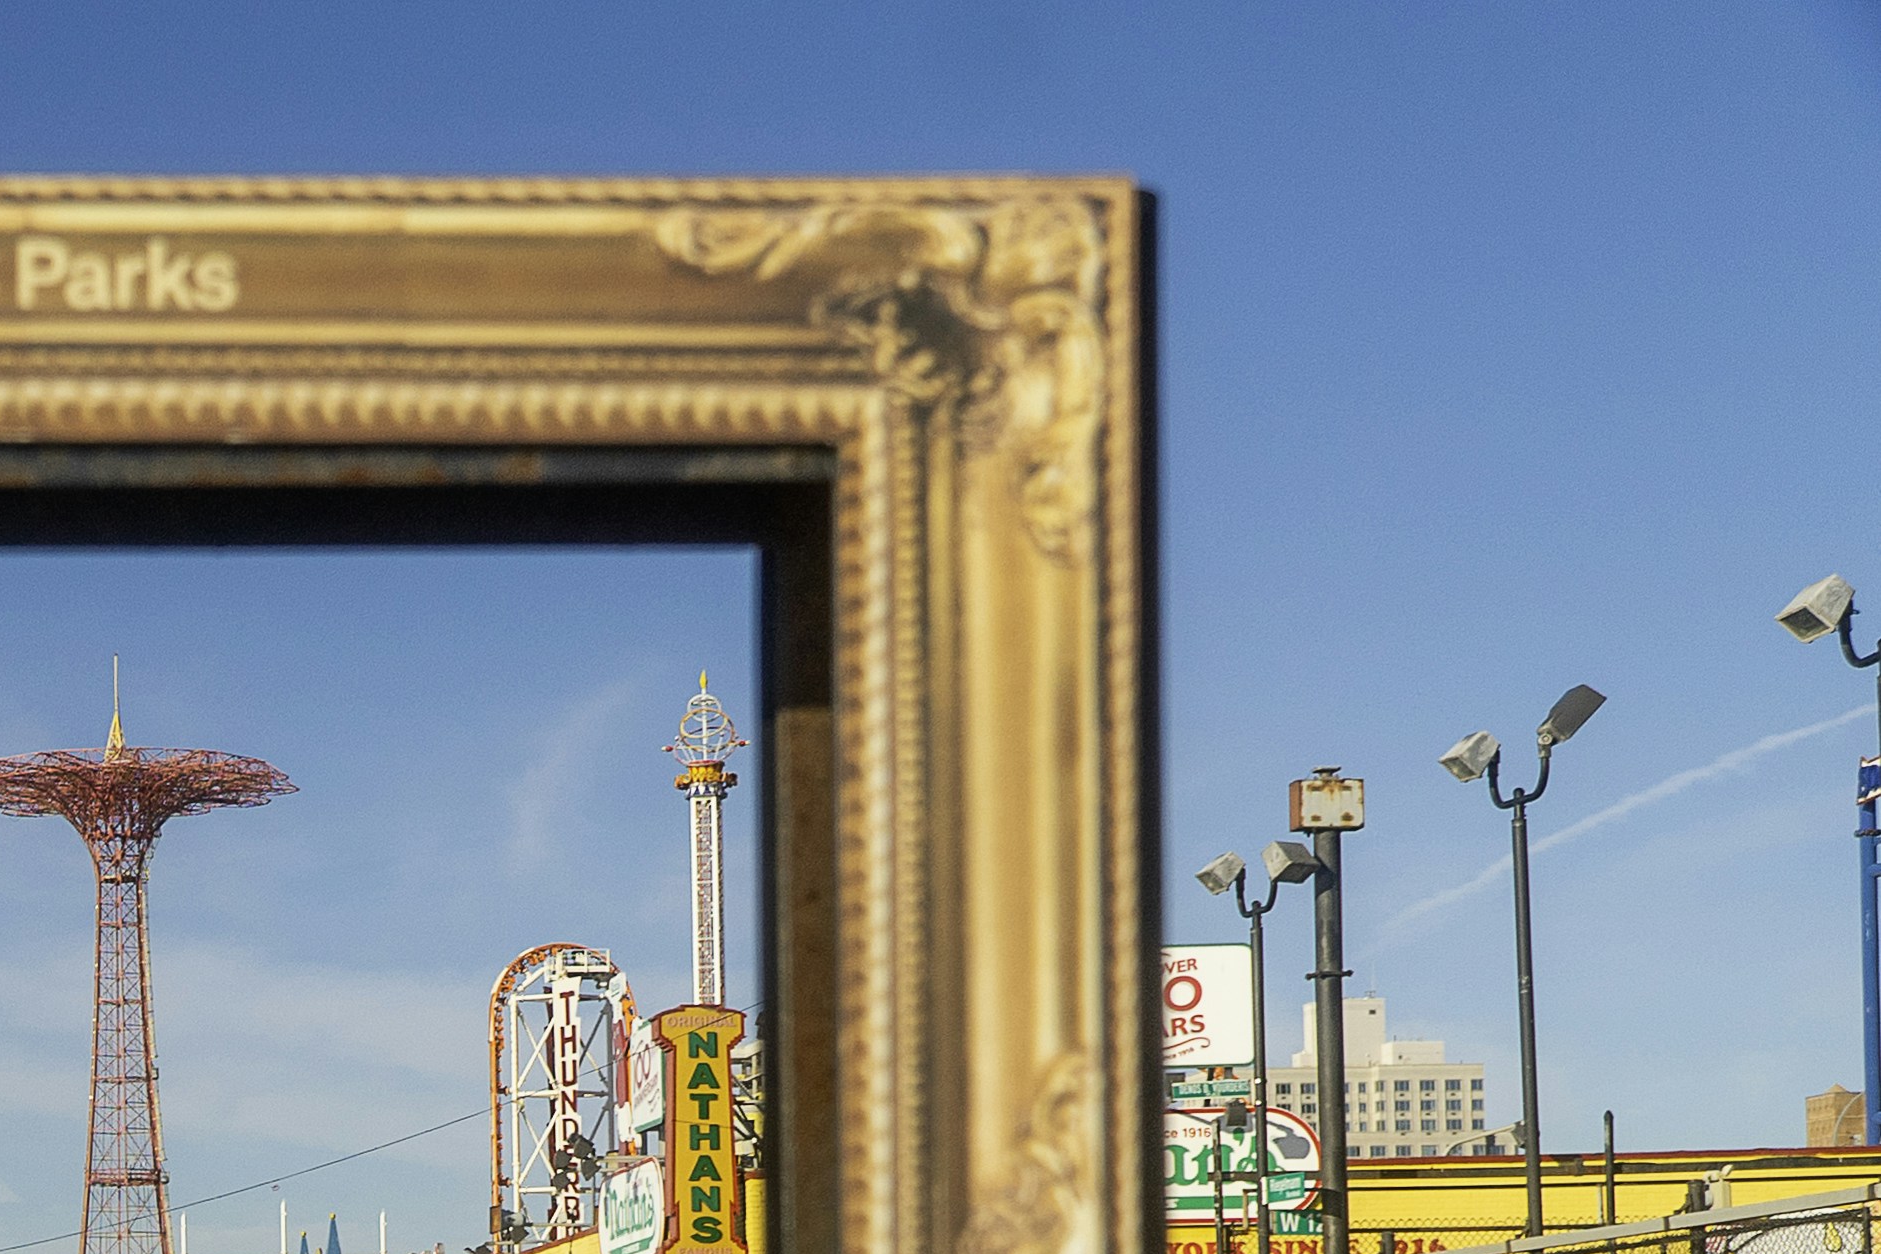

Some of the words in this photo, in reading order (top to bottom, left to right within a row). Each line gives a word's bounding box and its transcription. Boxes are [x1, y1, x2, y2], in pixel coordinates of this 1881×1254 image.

[16, 235, 241, 312] Parks
[1161, 957, 1198, 975] VER
[666, 1015, 738, 1029] ORIGINAL
[687, 1031, 724, 1245] NATHANS
[1183, 1128, 1212, 1138] 1916
[1280, 1212, 1300, 1233] W
